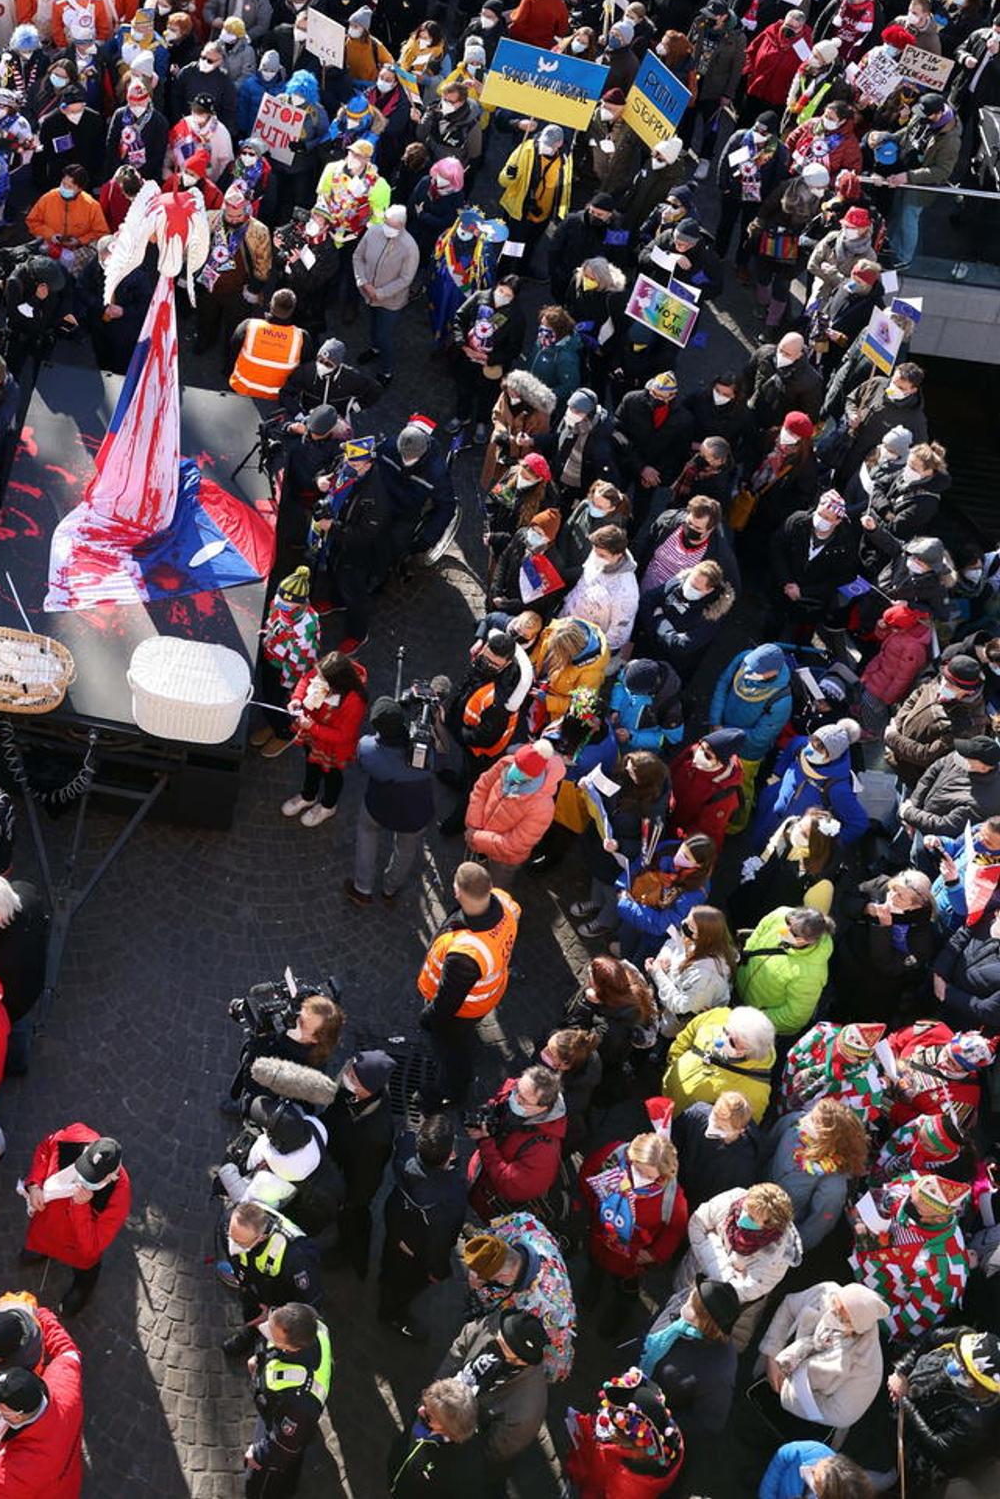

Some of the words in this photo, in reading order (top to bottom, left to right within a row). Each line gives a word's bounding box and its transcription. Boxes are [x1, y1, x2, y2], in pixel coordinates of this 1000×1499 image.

[644, 71, 679, 114] PUTIN
[262, 100, 303, 126] STOP
[253, 119, 298, 149] PUTIN
